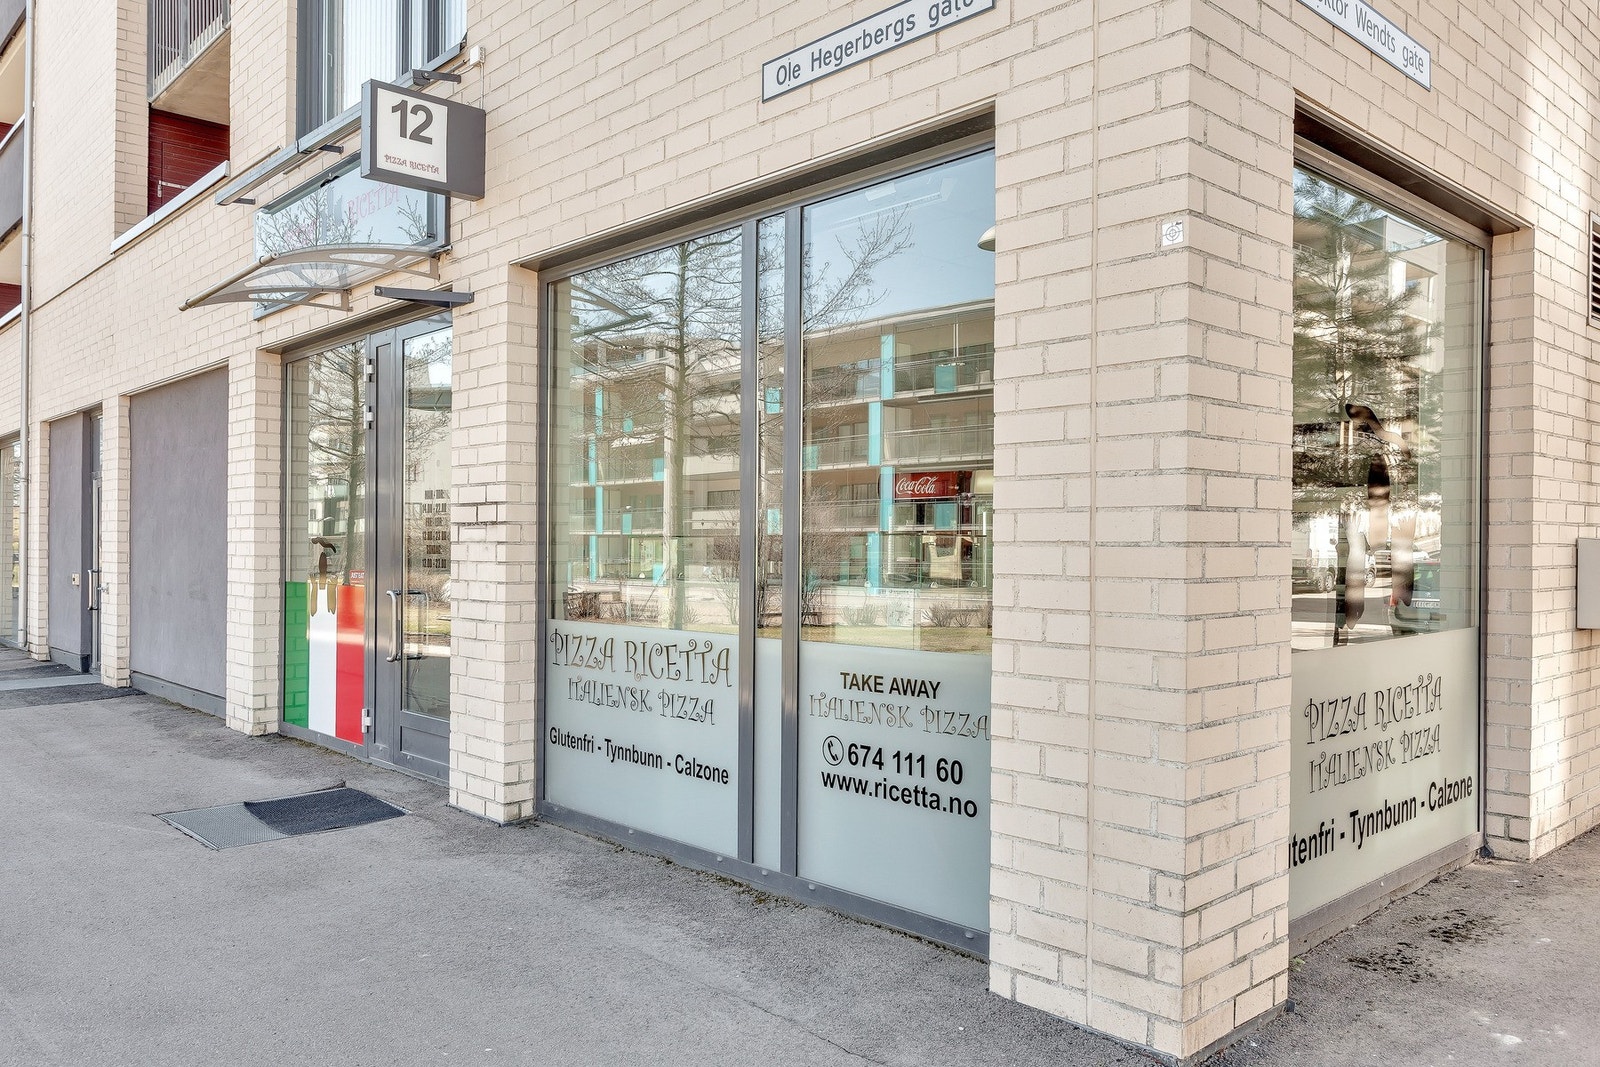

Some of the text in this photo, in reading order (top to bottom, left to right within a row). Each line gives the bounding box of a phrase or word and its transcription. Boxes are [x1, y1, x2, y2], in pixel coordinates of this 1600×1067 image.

[776, 62, 800, 86] Ole
[810, 13, 916, 72] Hegerbergs
[1355, 4, 1396, 54] Wendts
[1402, 46, 1424, 74] gate
[391, 99, 434, 146] 12
[384, 154, 440, 175] PIZZA RICETTA
[550, 628, 732, 687] PIZZA RICETTA
[567, 675, 715, 725] ITALIENSK PIZZA
[840, 671, 941, 700] TAKE AWAY
[1304, 672, 1442, 745] PIZZA RICETTA
[809, 691, 990, 741] ITALIENSK PIZZA
[549, 726, 594, 753] Glutenfri
[605, 738, 663, 769] Tynnbunn
[675, 754, 729, 785] Calzone
[847, 743, 964, 785] 674 111 60
[1309, 723, 1441, 794] ITALIENSK PIZZA
[821, 771, 978, 818] www.ricetta.no
[1349, 796, 1418, 850] Tynnbunn
[1428, 775, 1473, 812] Calzone
